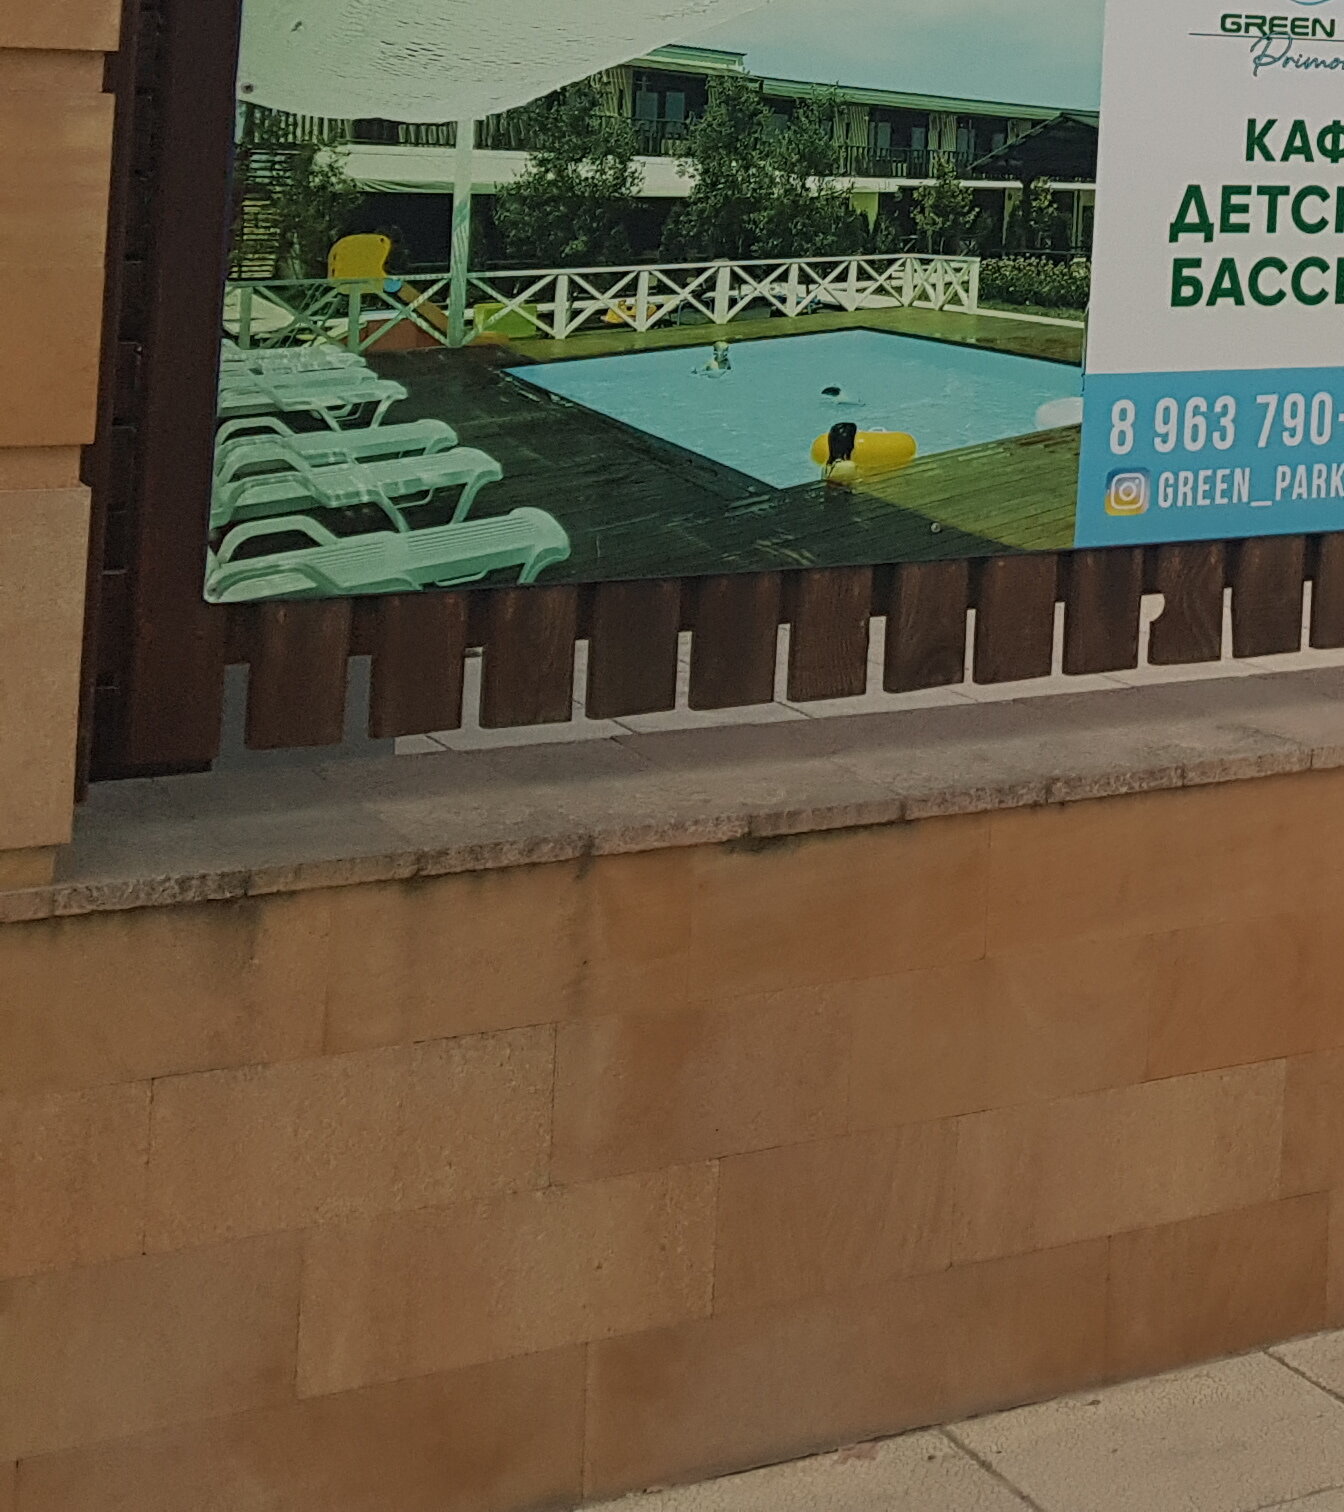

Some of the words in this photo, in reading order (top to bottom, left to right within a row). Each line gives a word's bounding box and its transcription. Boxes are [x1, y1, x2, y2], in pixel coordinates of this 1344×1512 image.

[1220, 13, 1336, 41] GREEN
[1109, 399, 1136, 455] 8
[1153, 395, 1237, 453] 963
